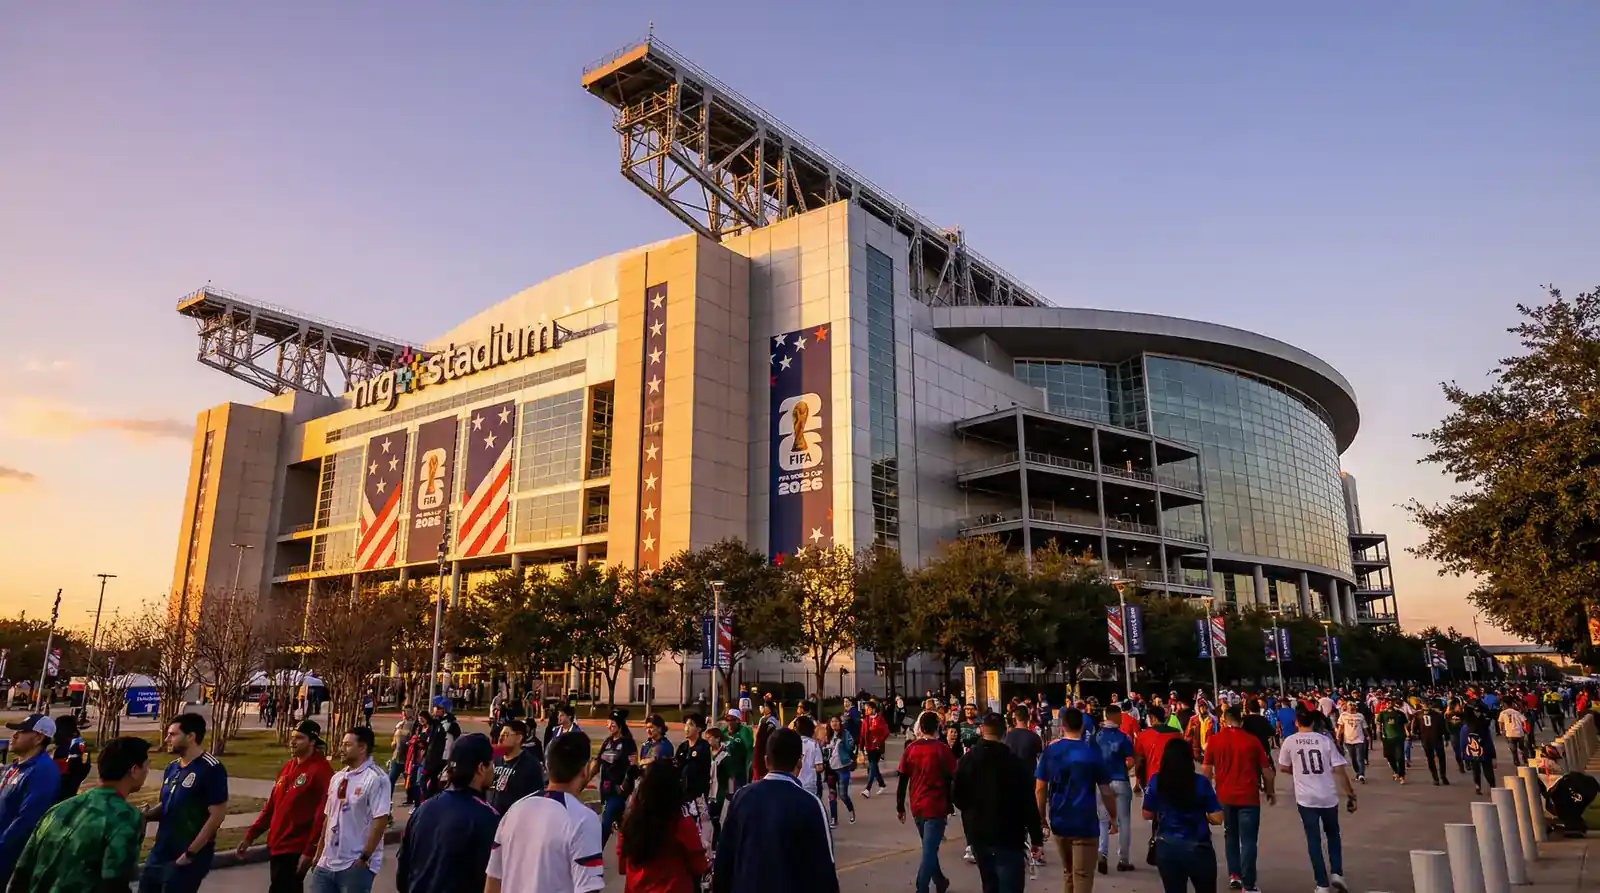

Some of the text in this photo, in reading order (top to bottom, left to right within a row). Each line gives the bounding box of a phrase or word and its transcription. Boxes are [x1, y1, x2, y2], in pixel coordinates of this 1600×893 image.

[352, 320, 556, 411] nrg stadium
[790, 453, 812, 465] FIFA
[778, 477, 823, 495] 2026
[424, 496, 437, 505] FIFA
[1297, 748, 1324, 775] 10
